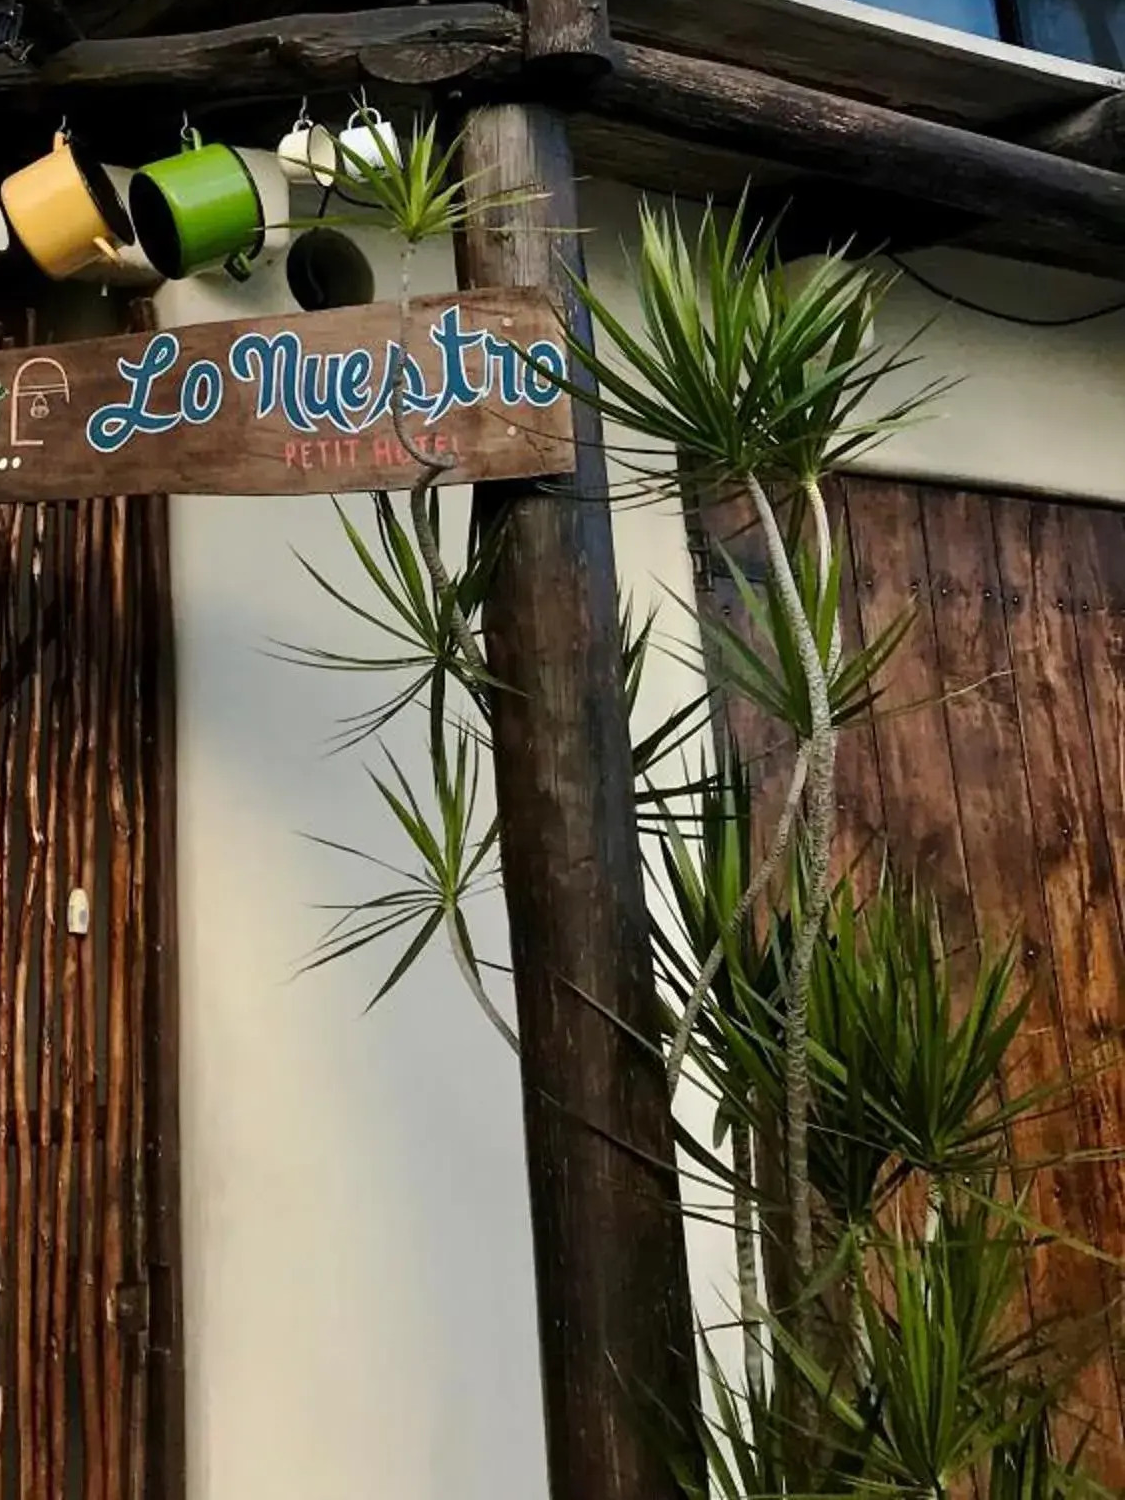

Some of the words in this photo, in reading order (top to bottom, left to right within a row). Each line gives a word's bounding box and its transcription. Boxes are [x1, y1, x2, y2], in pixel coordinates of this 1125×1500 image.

[86, 332, 224, 452] Lo
[228, 304, 568, 434] Nuestro
[284, 437, 360, 470] PETIT
